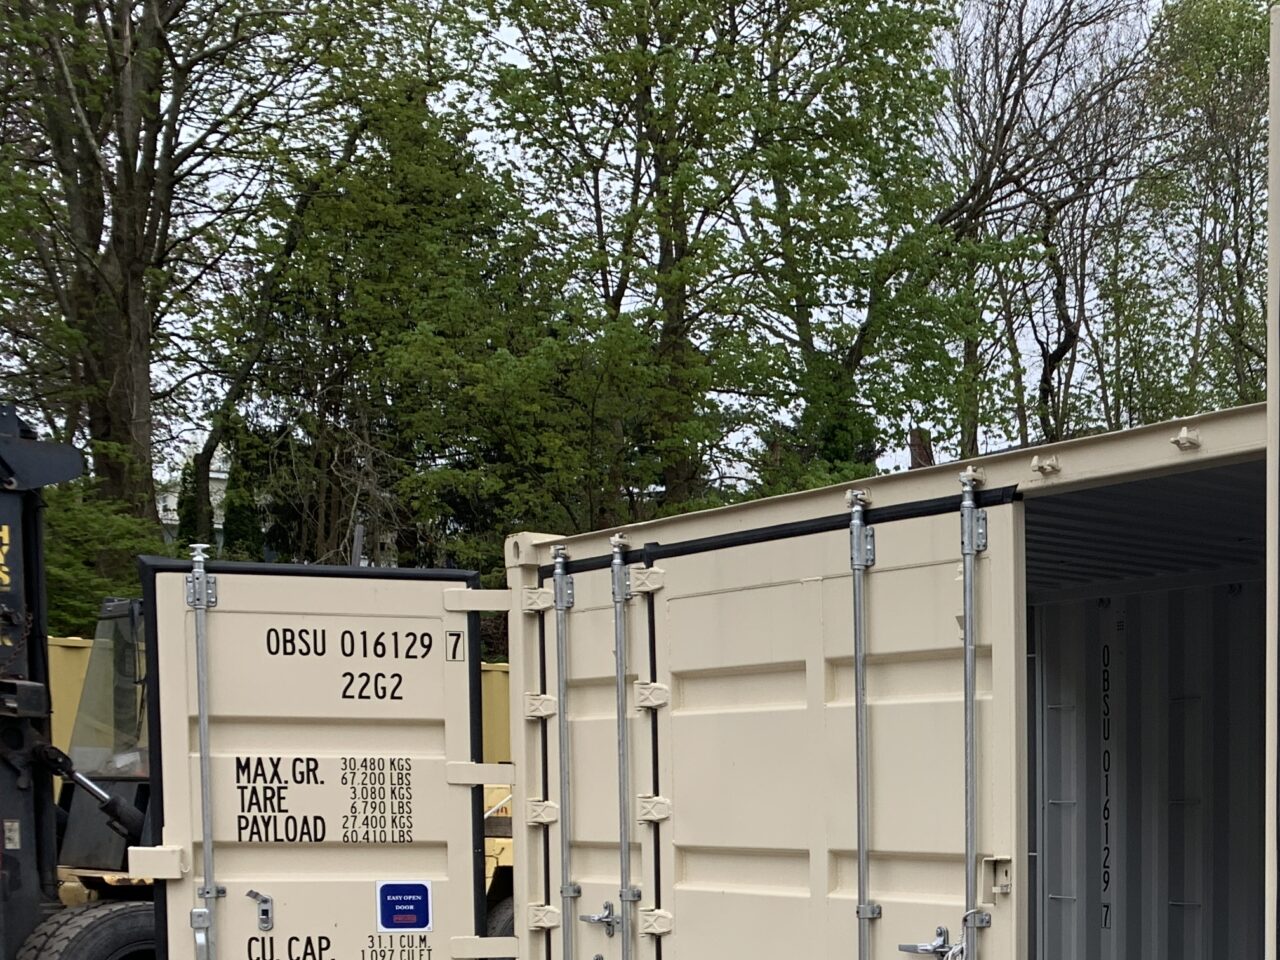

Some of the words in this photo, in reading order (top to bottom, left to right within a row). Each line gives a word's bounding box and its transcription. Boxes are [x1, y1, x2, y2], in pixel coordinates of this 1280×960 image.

[267, 628, 326, 656] OBSU
[341, 630, 433, 660] 016129
[449, 633, 461, 660] 7
[341, 672, 403, 700] 22G2
[1102, 644, 1111, 741] OBSU
[340, 758, 385, 771] 30.480
[389, 758, 412, 772] KGS
[340, 772, 386, 786] 67.200
[390, 772, 412, 786] LBS
[237, 786, 289, 813] TARE
[350, 786, 386, 800] 3.080
[390, 786, 413, 800] KGS
[350, 801, 387, 814] 6.790
[391, 801, 412, 814] LBS
[237, 815, 326, 842] PAYLOAD
[342, 815, 387, 829] 27.400
[391, 815, 413, 829] KGS
[1102, 750, 1111, 893] 016129
[342, 829, 387, 843] 60.410
[391, 829, 413, 843] LBS
[367, 935, 394, 949] 31.1
